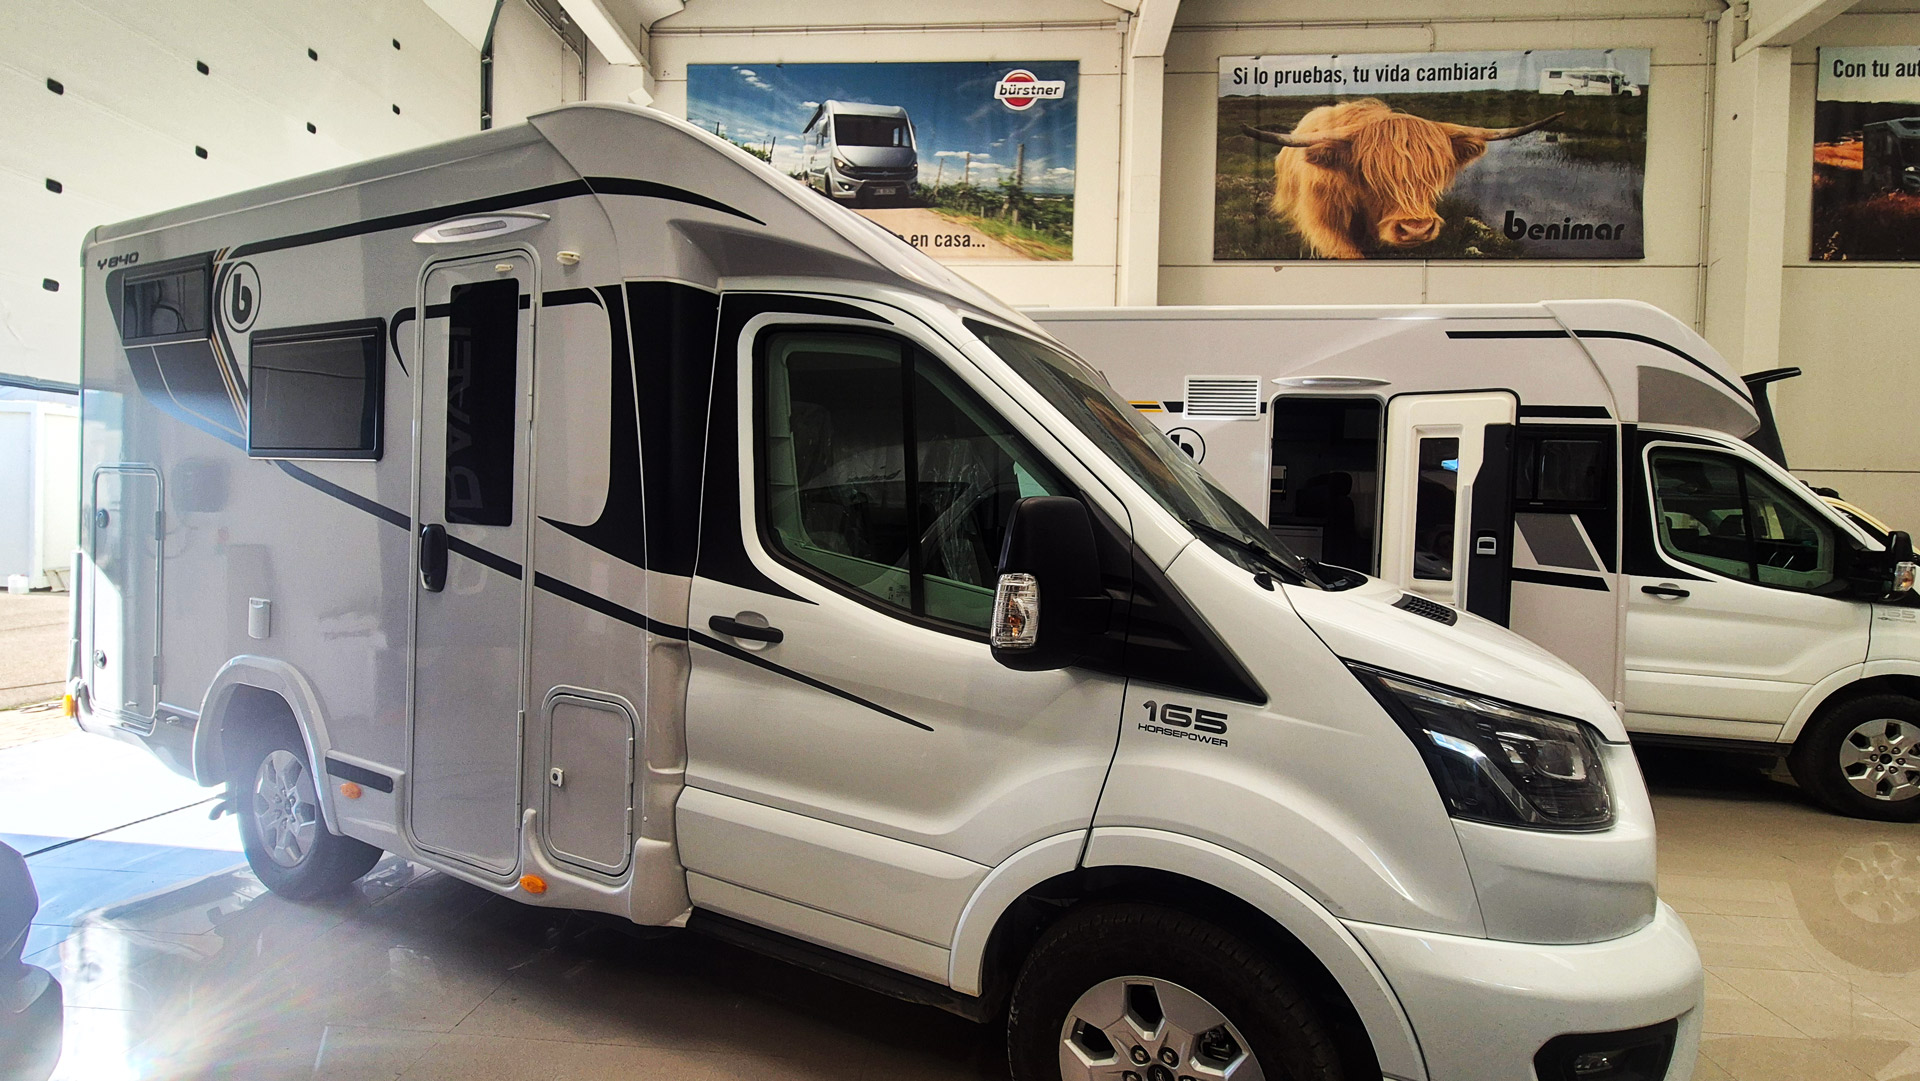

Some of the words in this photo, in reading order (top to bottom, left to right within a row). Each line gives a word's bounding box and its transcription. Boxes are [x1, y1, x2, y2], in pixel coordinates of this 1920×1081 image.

[1233, 67, 1248, 85] Si
[1254, 67, 1268, 84] lo
[1274, 66, 1347, 88] pruebas,
[1353, 65, 1369, 82] tu
[1375, 64, 1410, 82] vida
[1416, 61, 1498, 81] cambiará
[1833, 59, 1866, 78] Con
[1872, 60, 1889, 77] tu
[999, 84, 1060, 96] bürstner
[1503, 210, 1625, 240] benimar
[910, 234, 928, 247] en
[934, 234, 985, 247] casa...
[231, 273, 252, 325] b
[1142, 699, 1229, 735] 165
[1138, 723, 1229, 748] HORSEPOWER
